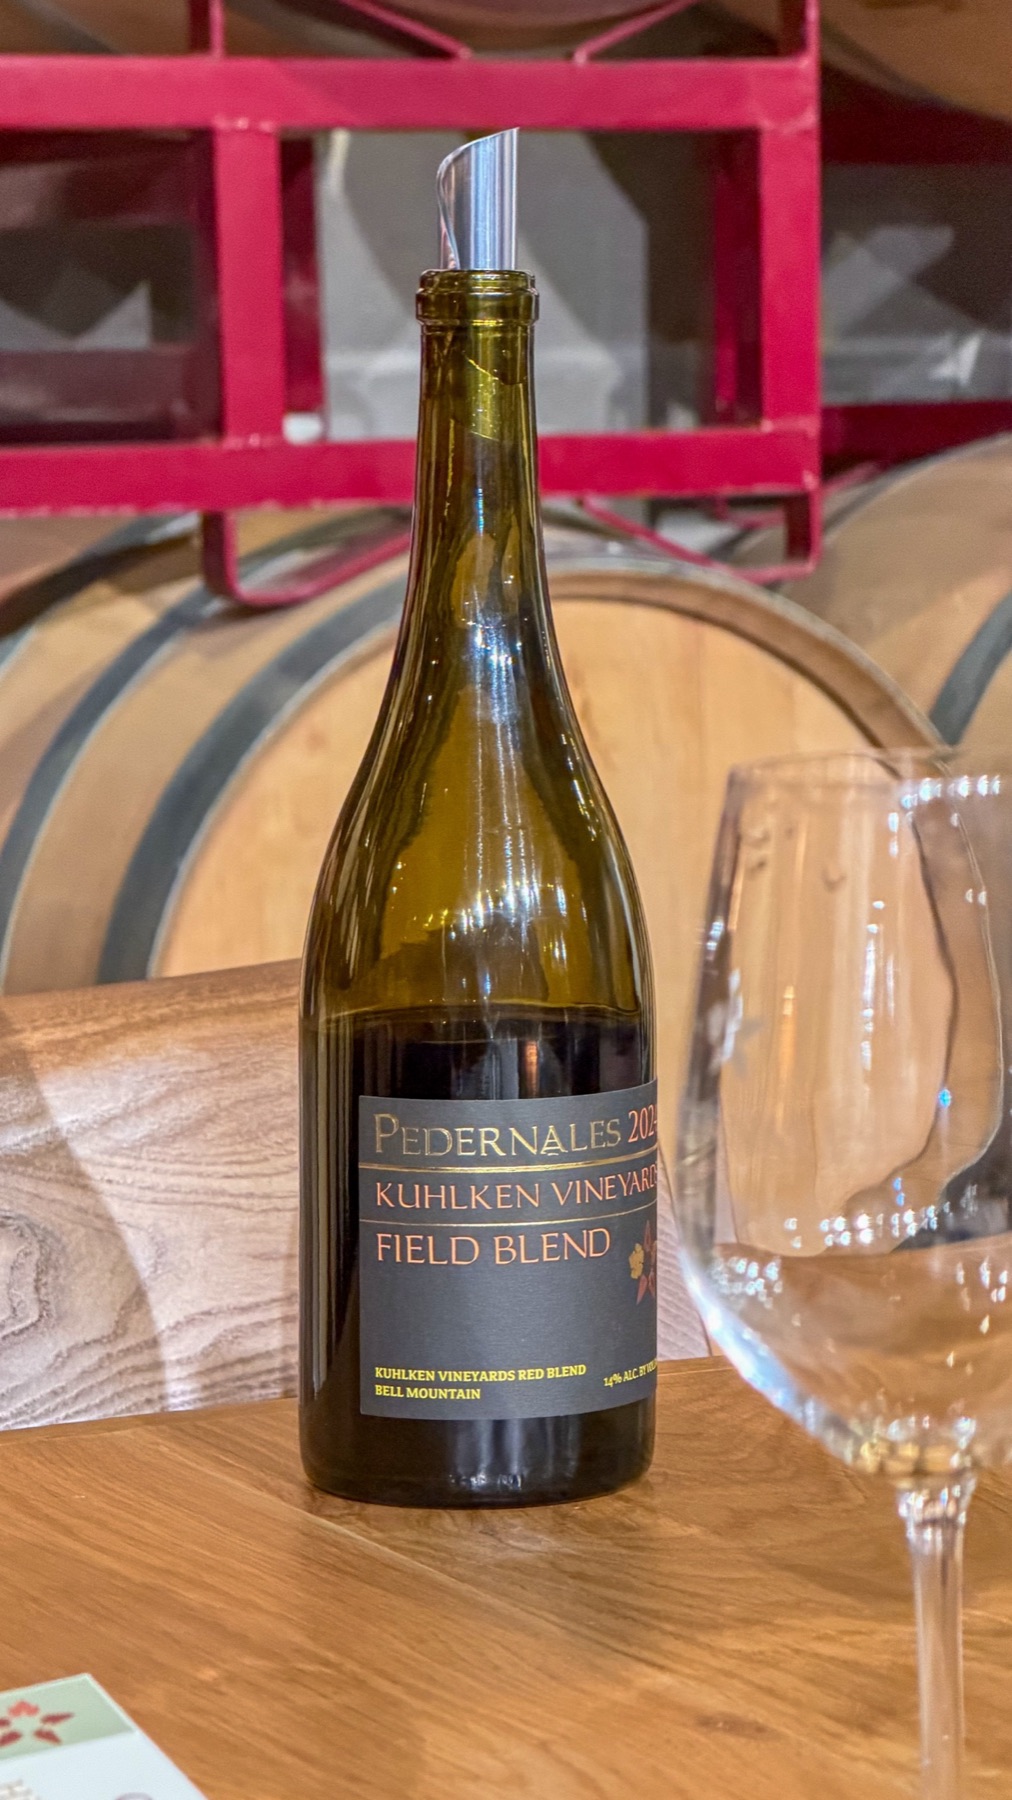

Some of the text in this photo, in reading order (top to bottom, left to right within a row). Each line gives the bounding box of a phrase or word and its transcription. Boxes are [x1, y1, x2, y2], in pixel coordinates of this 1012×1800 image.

[373, 1113, 621, 1157] PEDERNALES
[376, 1182, 539, 1210] KUHLKEN
[376, 1228, 611, 1265] FIELD BLEND
[375, 1364, 587, 1382] KUHLKEN VINEYARDS RED BLEND
[603, 1373, 622, 1388] 14%
[375, 1384, 481, 1400] BELL MOUNTAIN
